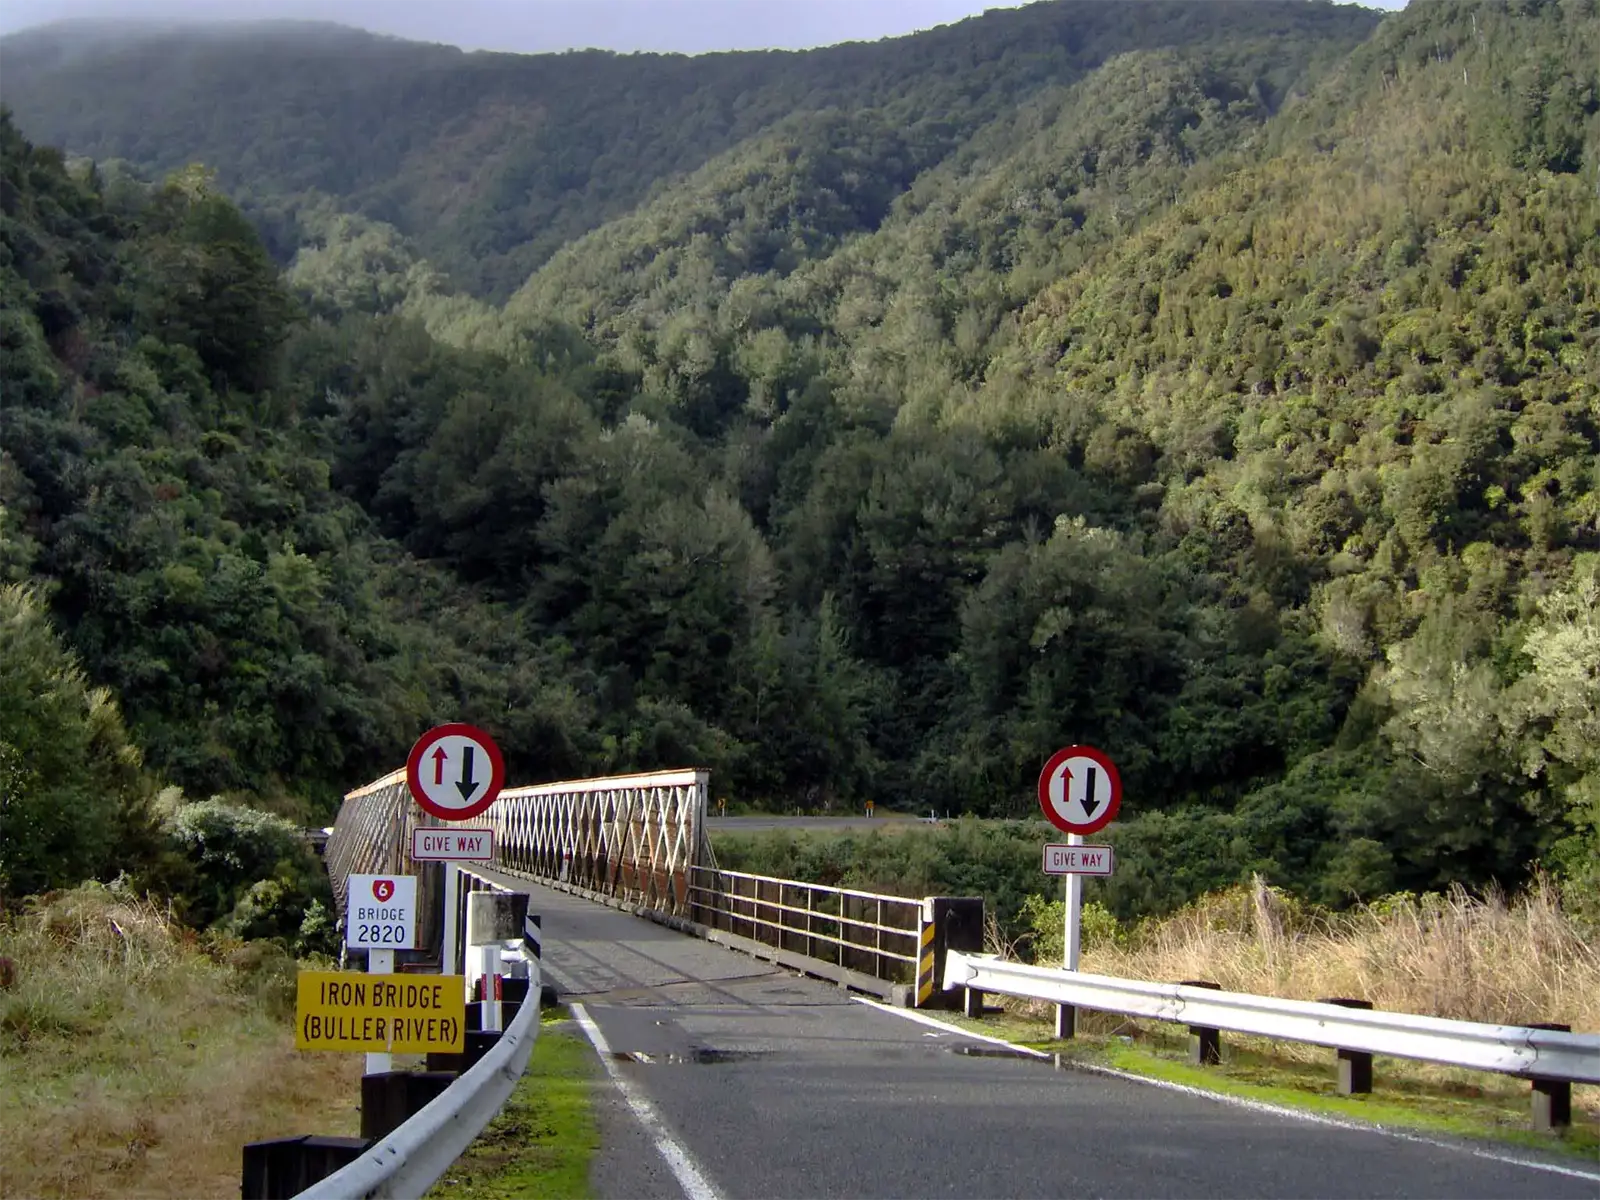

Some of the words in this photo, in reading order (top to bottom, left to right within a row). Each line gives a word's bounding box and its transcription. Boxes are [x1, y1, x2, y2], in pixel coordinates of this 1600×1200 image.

[423, 836, 451, 852] GIVE
[457, 837, 482, 851] WAY
[1053, 852, 1075, 866] GIVE
[1081, 853, 1103, 867] WAY
[378, 883, 388, 896] 6
[358, 908, 405, 921] BRIDGE
[358, 925, 405, 943] 2820
[321, 982, 365, 1007] IRON
[373, 983, 442, 1009] BRIDGE
[304, 1013, 386, 1041] (BULLER
[393, 1016, 458, 1044] RIVER)
